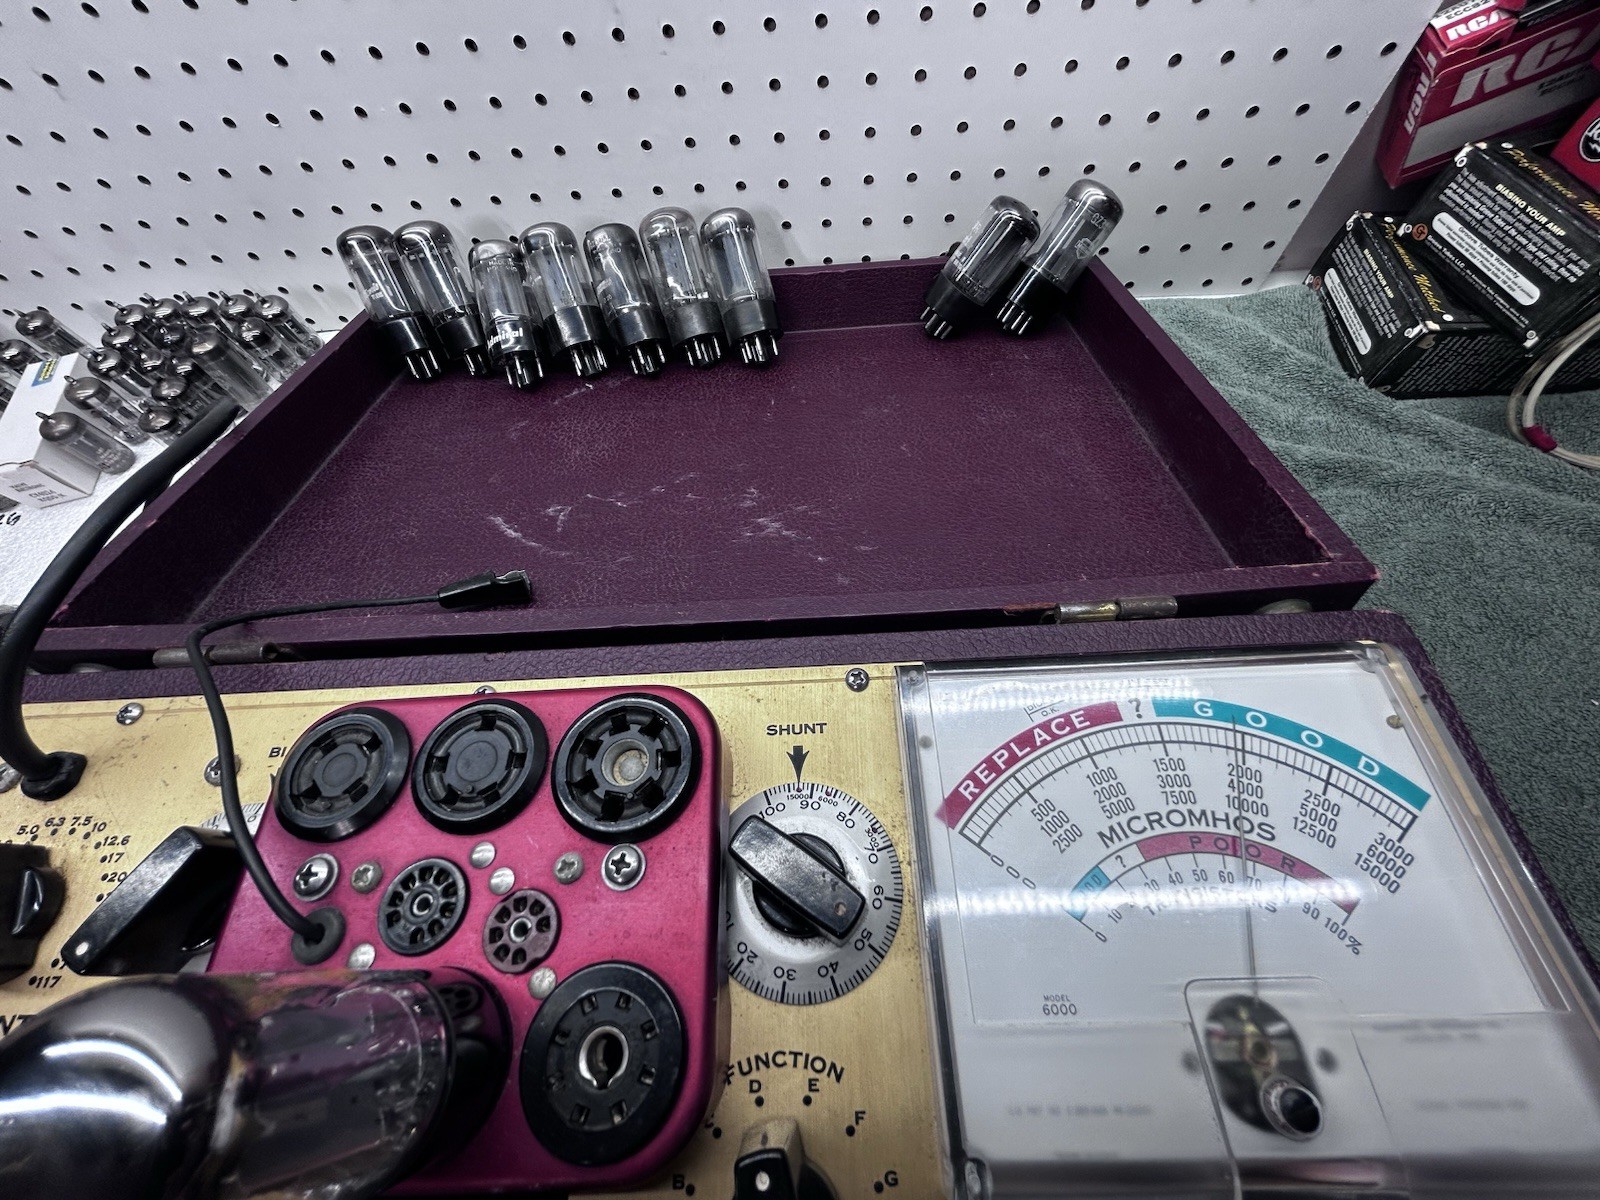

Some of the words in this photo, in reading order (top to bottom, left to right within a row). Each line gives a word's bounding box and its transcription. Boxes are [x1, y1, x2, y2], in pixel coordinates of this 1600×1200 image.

[1446, 9, 1508, 41] RCA
[1495, 183, 1527, 209] BIASING
[1525, 205, 1549, 225] YOUR
[1545, 222, 1566, 237] AMP
[1375, 269, 1387, 289] YOUR
[766, 722, 827, 736] SHUNT
[958, 710, 1091, 801] REPLACE
[1129, 699, 1143, 719] ?
[786, 793, 810, 801] 15000
[818, 795, 838, 807] 6000
[800, 800, 821, 811] 90
[836, 811, 855, 829] 80
[1030, 798, 1056, 822] 500
[1086, 766, 1118, 787] 1000
[1152, 757, 1186, 772] 1500
[1227, 763, 1262, 784] 2000
[1303, 789, 1341, 817] 2500
[1374, 832, 1415, 867] 3000
[16, 825, 40, 835] 5.0
[44, 817, 66, 827] 6.3
[70, 816, 94, 826] 7.5
[91, 822, 107, 833] 10
[102, 835, 131, 846] 12.6
[1040, 809, 1070, 837] 1000
[1093, 781, 1127, 804] 2000
[1156, 773, 1191, 789] 3000
[1227, 780, 1264, 799] 4000
[1299, 802, 1338, 832] 5000
[1366, 843, 1406, 880] 6000
[1097, 808, 1276, 849] MICROMHOS
[1052, 823, 1083, 854] 2500
[1101, 796, 1135, 819] 5000
[1160, 789, 1197, 805] 7500
[1225, 794, 1269, 818] 10000
[1292, 816, 1337, 849] 12500
[1354, 852, 1401, 894] 15000
[107, 852, 125, 863] 17
[864, 844, 879, 865] 70
[1115, 854, 1127, 869] ?
[1190, 836, 1296, 873] POOR
[106, 871, 128, 882] 20
[872, 885, 884, 910] 60
[1107, 908, 1122, 923] 10
[1168, 872, 1184, 886] 40
[1191, 869, 1208, 882] 50
[1218, 870, 1234, 884] 60
[1302, 902, 1320, 920] 90
[1324, 917, 1363, 956] 100%
[854, 927, 873, 951] 50
[737, 941, 759, 964] 20
[773, 966, 797, 981] 30
[817, 960, 839, 978] 40
[36, 975, 62, 989] 117
[1043, 994, 1071, 1002] MODEL
[1042, 1003, 1078, 1016] 6000
[725, 1050, 845, 1086] FUNCTION
[750, 1079, 762, 1094] D
[808, 1078, 820, 1093] E
[855, 1110, 866, 1126] F
[672, 1174, 685, 1190] B
[884, 1170, 899, 1188] G
